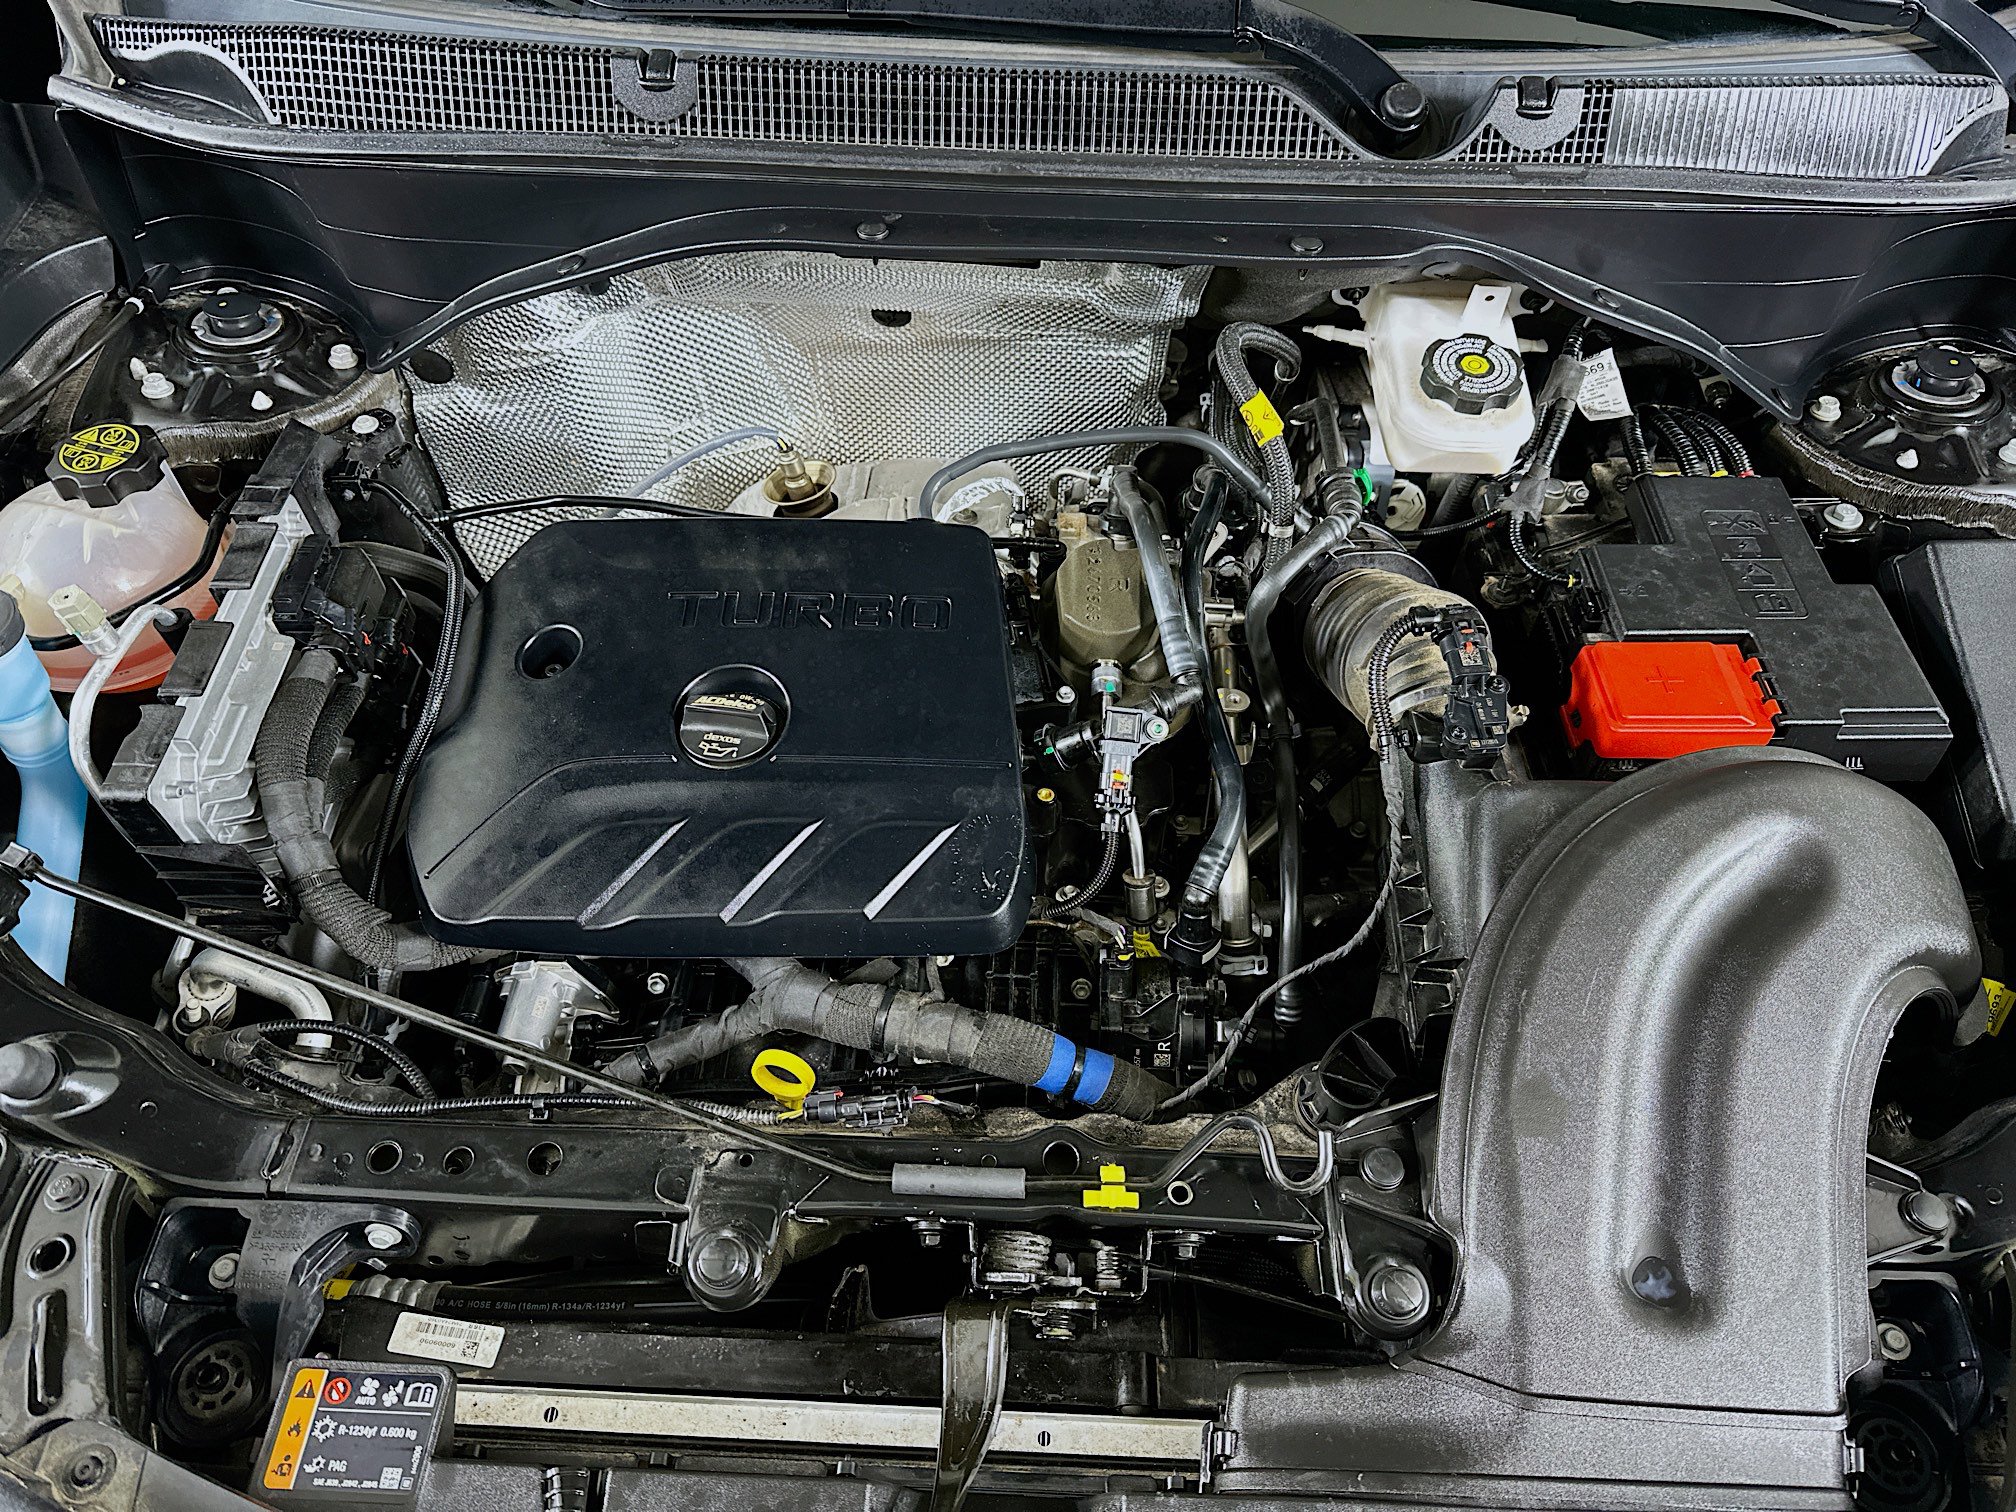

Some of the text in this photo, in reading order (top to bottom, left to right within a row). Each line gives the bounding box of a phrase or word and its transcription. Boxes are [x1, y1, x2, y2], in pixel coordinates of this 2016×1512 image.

[668, 591, 952, 632] TURBO
[692, 696, 757, 710] ACDelco
[703, 732, 741, 745] dexos
[1157, 1042, 1171, 1051] R
[448, 1300, 464, 1308] A/C
[467, 1300, 492, 1309] HOSE
[495, 1301, 517, 1310] 5/8in
[518, 1302, 551, 1312] (16mm)
[551, 1302, 626, 1312] R-134a/R-1234yf
[354, 1395, 377, 1406] AUTO
[338, 1424, 418, 1441] R-1234yf 0.600 kg
[327, 1459, 348, 1473] PAG
